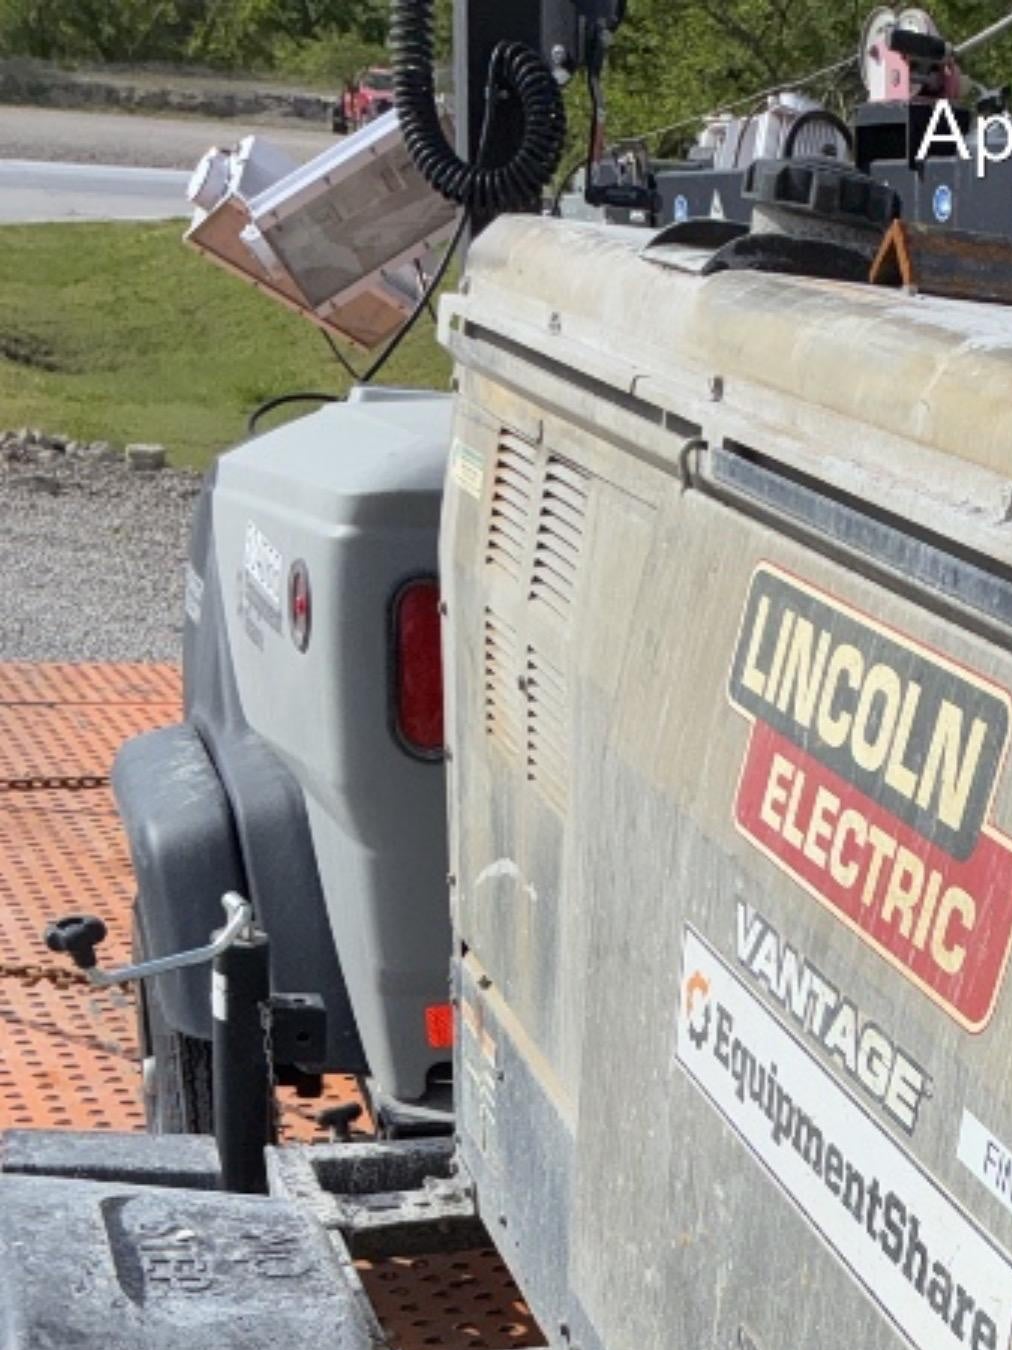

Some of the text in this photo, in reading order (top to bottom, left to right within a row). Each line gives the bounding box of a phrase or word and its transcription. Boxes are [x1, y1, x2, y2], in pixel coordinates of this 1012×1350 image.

[740, 595, 987, 832] LINCOLN
[760, 752, 977, 976] ELECTRIC
[735, 903, 929, 1137] VANTAGE
